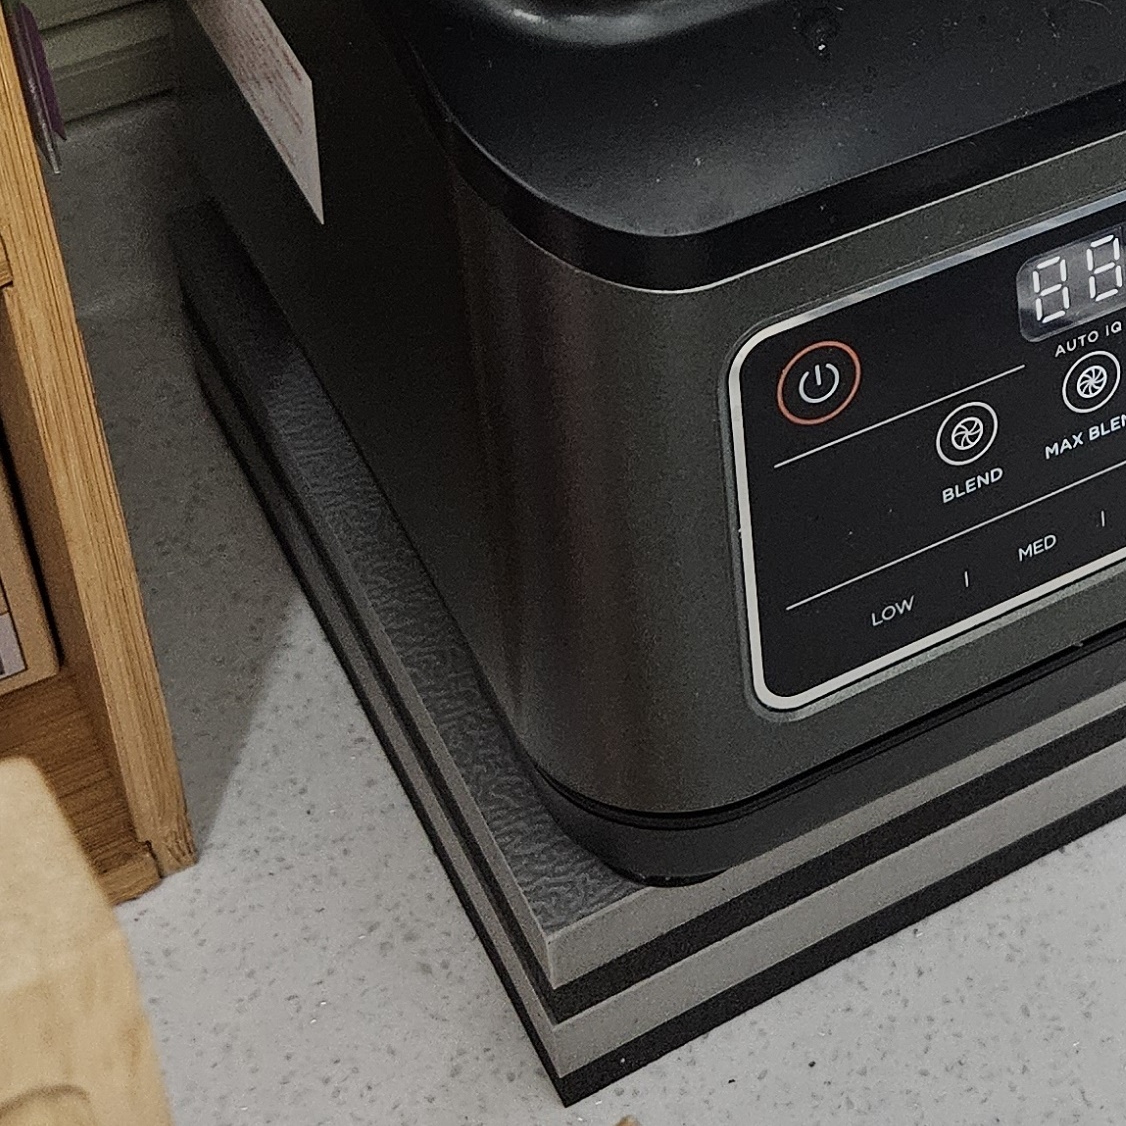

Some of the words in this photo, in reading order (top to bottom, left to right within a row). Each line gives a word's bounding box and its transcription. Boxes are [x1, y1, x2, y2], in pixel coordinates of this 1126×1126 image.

[1055, 331, 1099, 357] AUTO
[1105, 321, 1122, 337] IQ
[1044, 432, 1084, 460] MAX
[941, 467, 1003, 504] BLEND
[870, 596, 915, 627] LOW
[1018, 534, 1057, 561] MED
